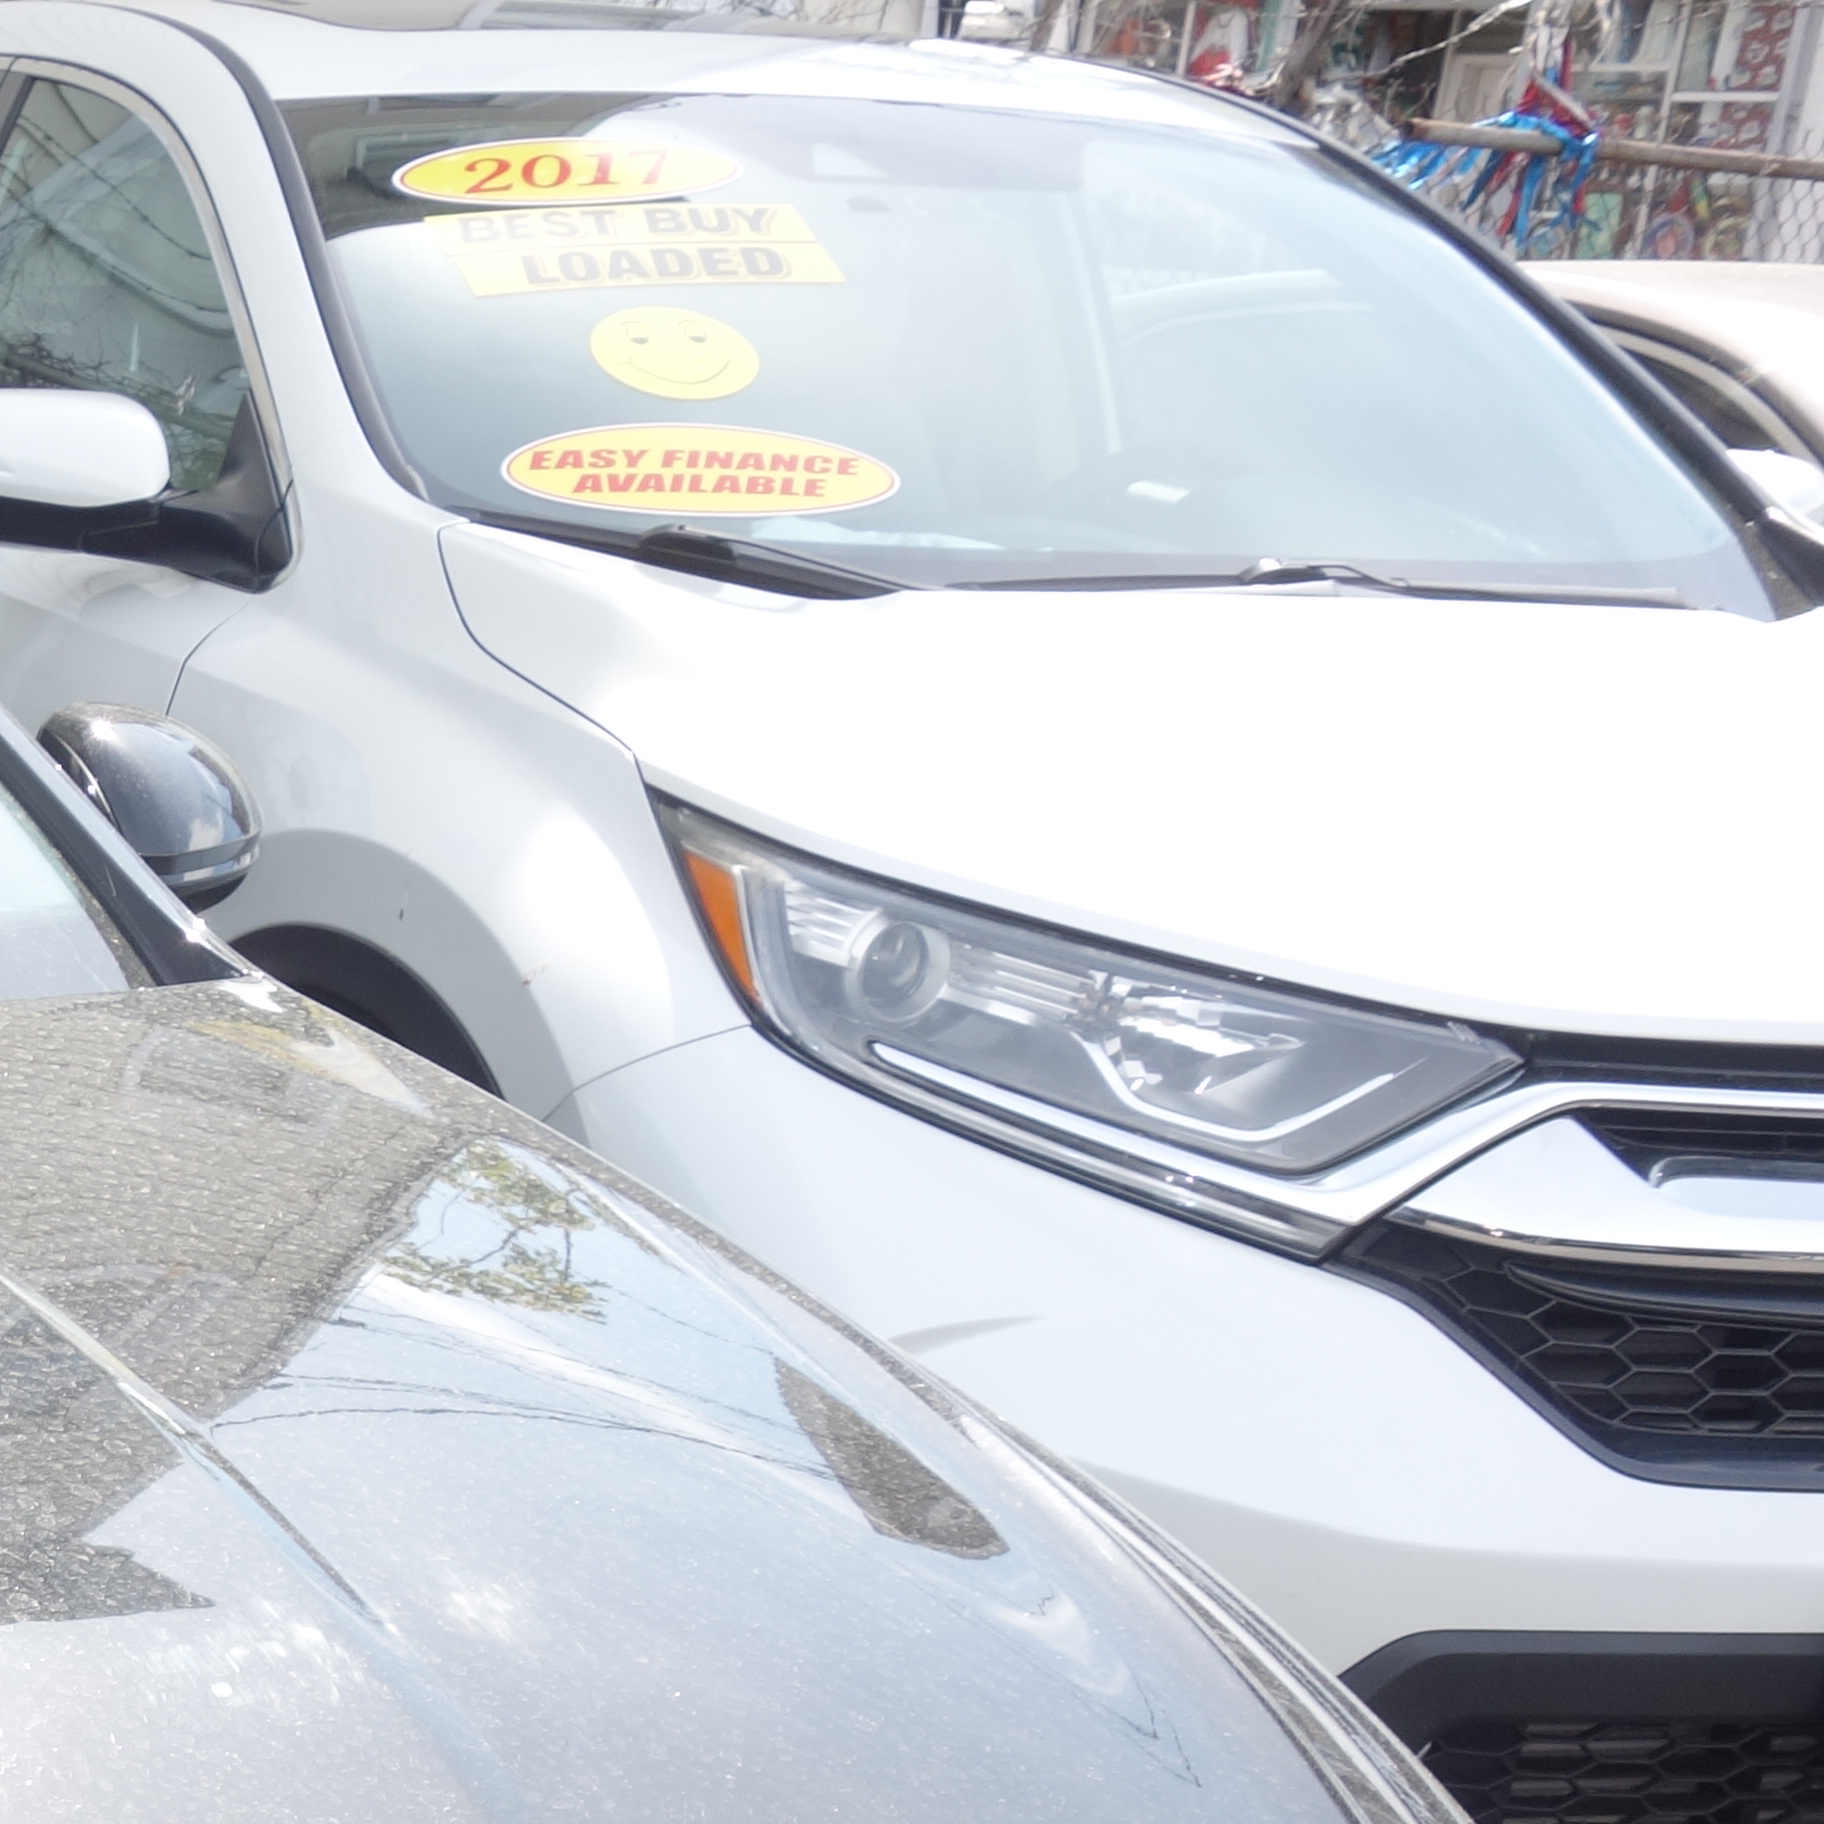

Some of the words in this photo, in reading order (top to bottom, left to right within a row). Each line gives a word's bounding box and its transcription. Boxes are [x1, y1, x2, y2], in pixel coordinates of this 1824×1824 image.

[463, 149, 669, 195] 2017
[457, 206, 618, 245] BEST
[642, 206, 779, 238] BUY
[519, 245, 792, 286] LOADED
[528, 448, 649, 471] EASY
[660, 449, 859, 476] FINANCE
[571, 473, 827, 498] AVAILABLE
